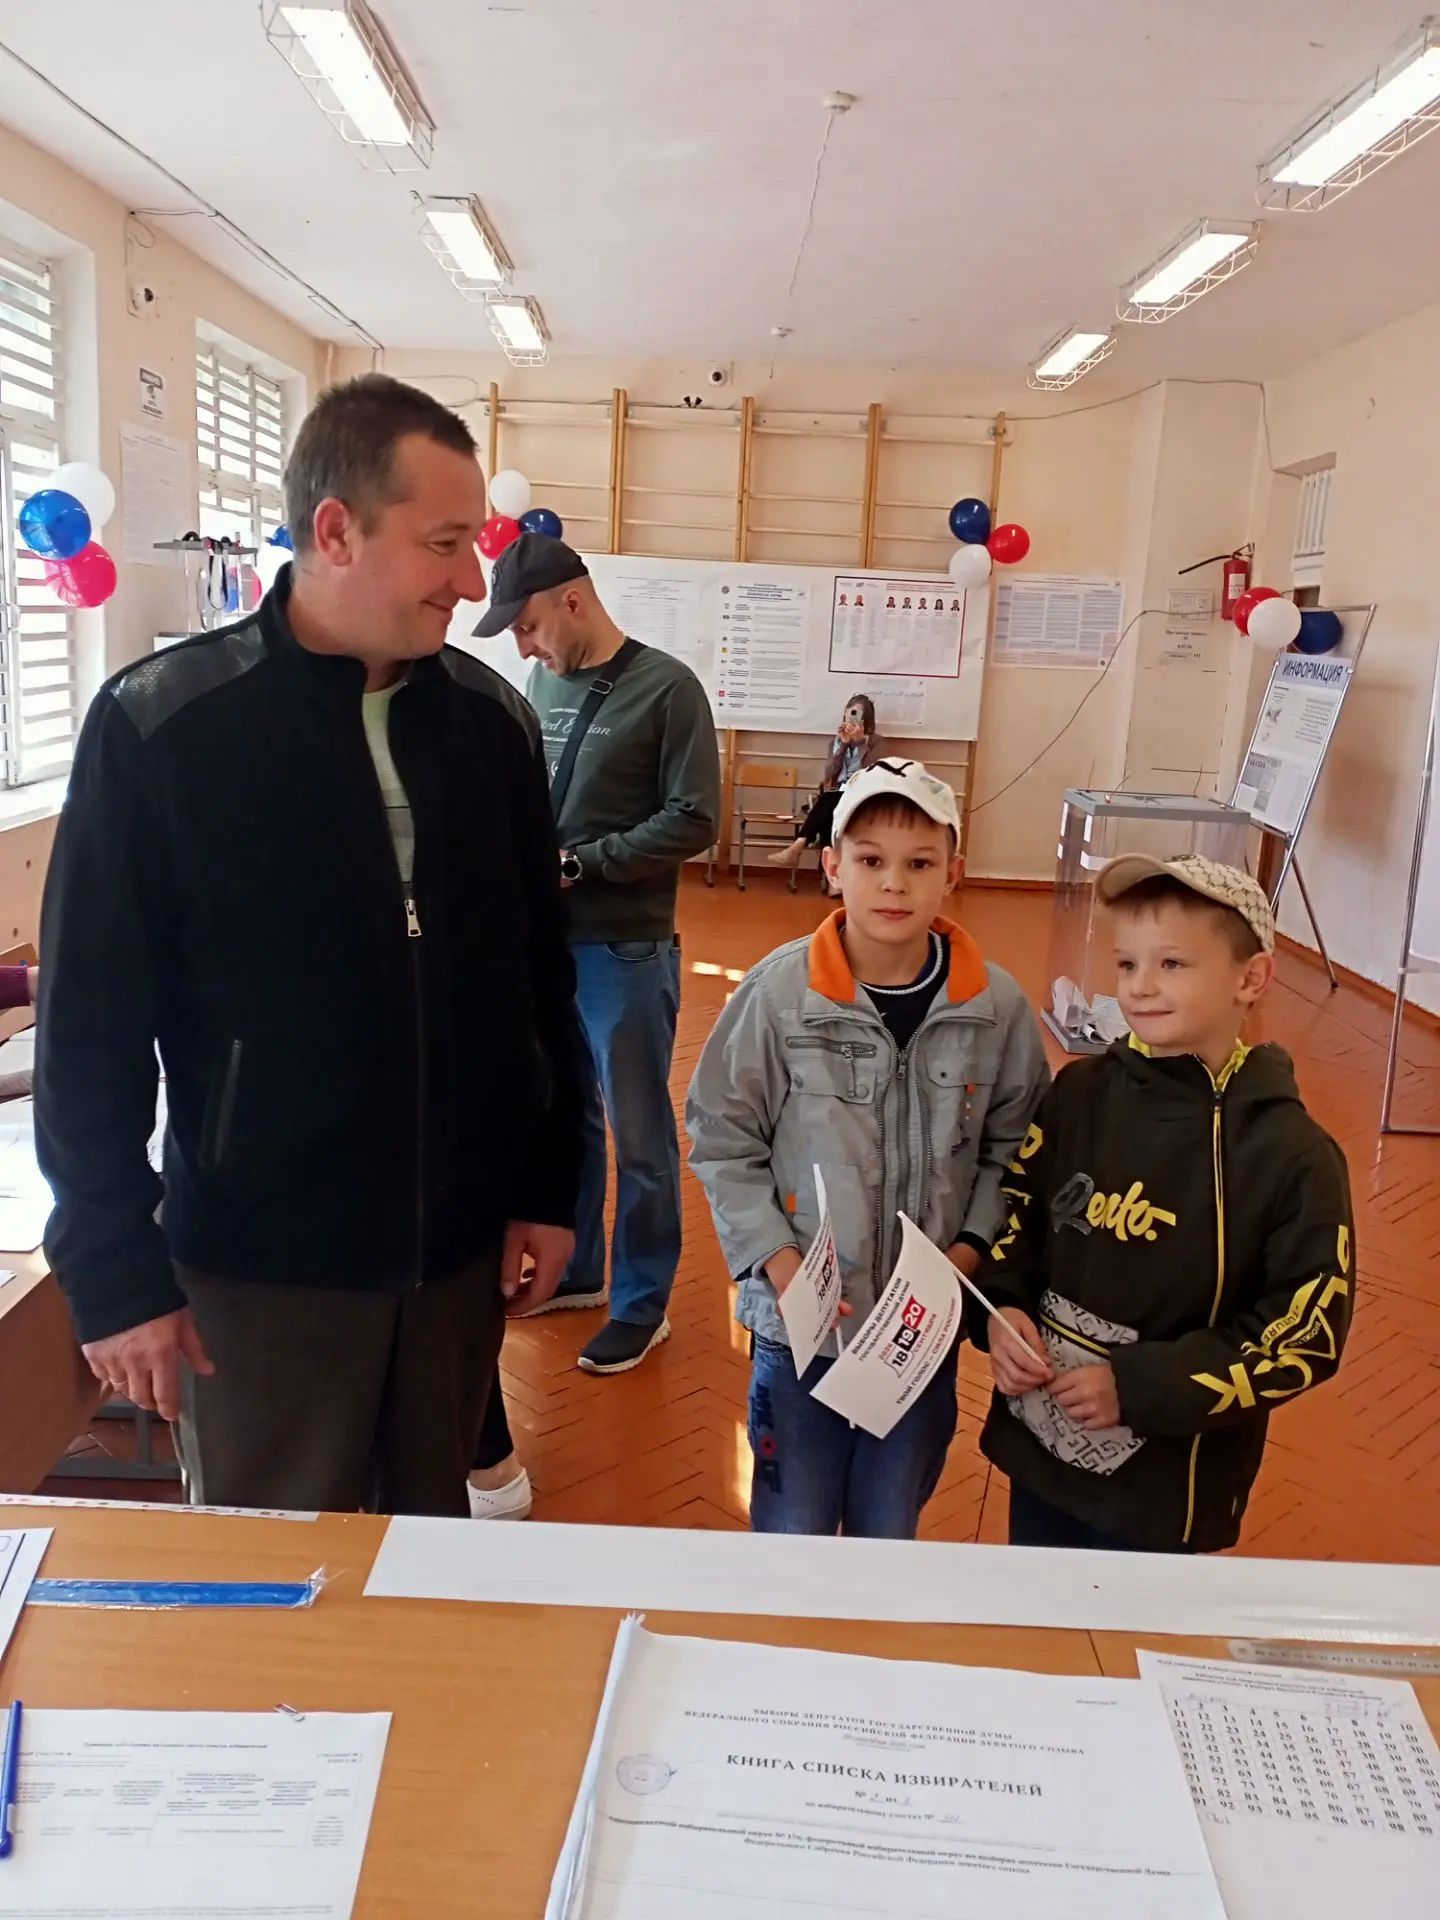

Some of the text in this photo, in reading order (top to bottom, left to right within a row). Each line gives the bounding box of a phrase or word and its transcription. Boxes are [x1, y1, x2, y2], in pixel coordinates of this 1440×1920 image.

[1282, 660, 1343, 685] ИНФОРМАЦИЯ
[852, 1277, 902, 1355] ВЫБОРЫ ДЕПУТАТОВ
[892, 1304, 922, 1366] 18 19 20
[912, 1361, 929, 1386] ГОЛОС
[753, 1708, 799, 1718] ВЫБОРЫ
[727, 1754, 795, 1771] КНИГА
[802, 1761, 887, 1783] СПИСКА
[894, 1772, 1043, 1797] ИЗБИРАТЕЛЕЙ
